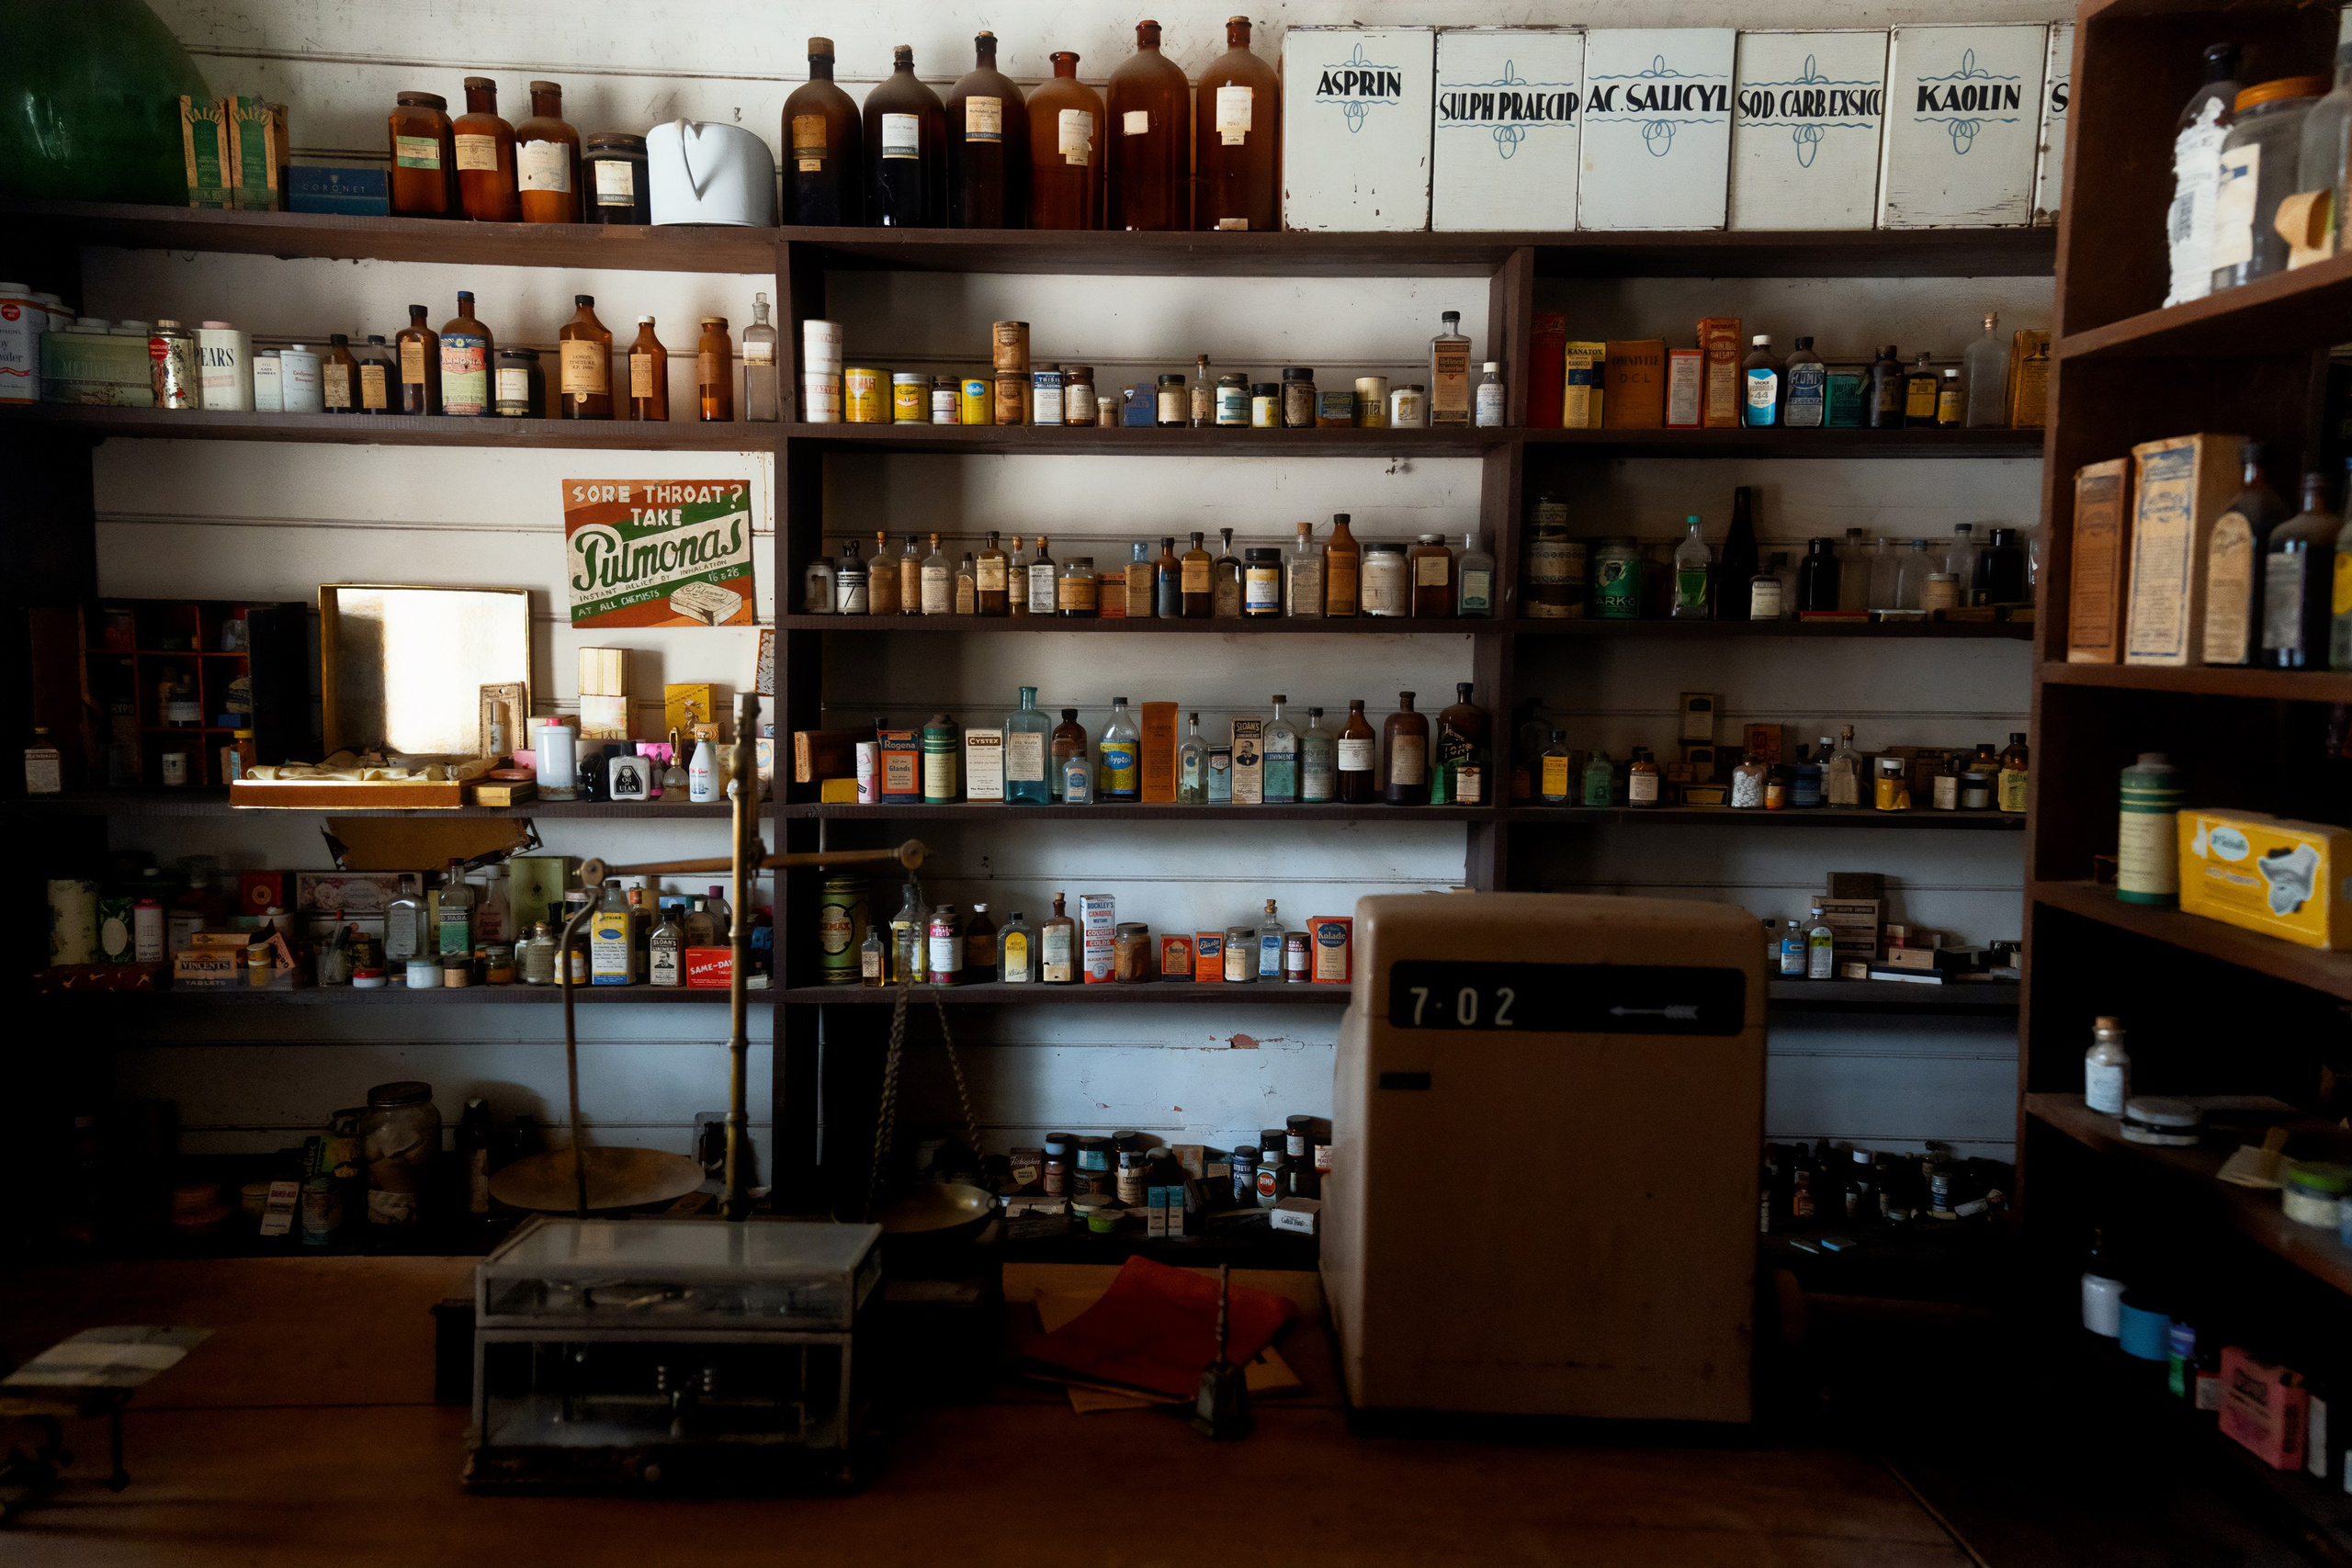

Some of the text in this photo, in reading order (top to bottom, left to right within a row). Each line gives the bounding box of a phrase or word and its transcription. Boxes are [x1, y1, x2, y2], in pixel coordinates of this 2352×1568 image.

[1317, 71, 1401, 97] ASPRIN
[1625, 84, 1732, 112] SALICYL
[1917, 85, 2021, 112] KAOLIN
[1439, 91, 1579, 121] SULPH PRAECIP
[301, 183, 366, 194] CORONET
[1567, 347, 1603, 355] KANATOX
[1710, 351, 1736, 359] BALSAM
[194, 347, 234, 367] PEARS
[442, 355, 483, 366] AMMONIA
[571, 485, 631, 502] SORE
[630, 508, 683, 526] TAKE
[571, 518, 742, 592] Pulmonas
[579, 588, 617, 602] INSTANT
[626, 578, 654, 590] RELIEF
[680, 559, 727, 575] INHALATION
[578, 590, 660, 616] AT ALL CHEMISTS
[110, 704, 135, 715] HYPO
[1236, 721, 1261, 732] SLOAN'S
[884, 739, 916, 750] Rogena
[968, 737, 999, 745] CYSTEX
[1267, 753, 1294, 761] LINIMENT
[888, 764, 910, 773] Glands
[1317, 931, 1347, 941] Kolade
[180, 960, 230, 970] VINCENT'S
[690, 959, 733, 976] SAME-DAY
[1260, 1176, 1273, 1185] DIMP
[271, 1190, 297, 1198] BAND-AID
